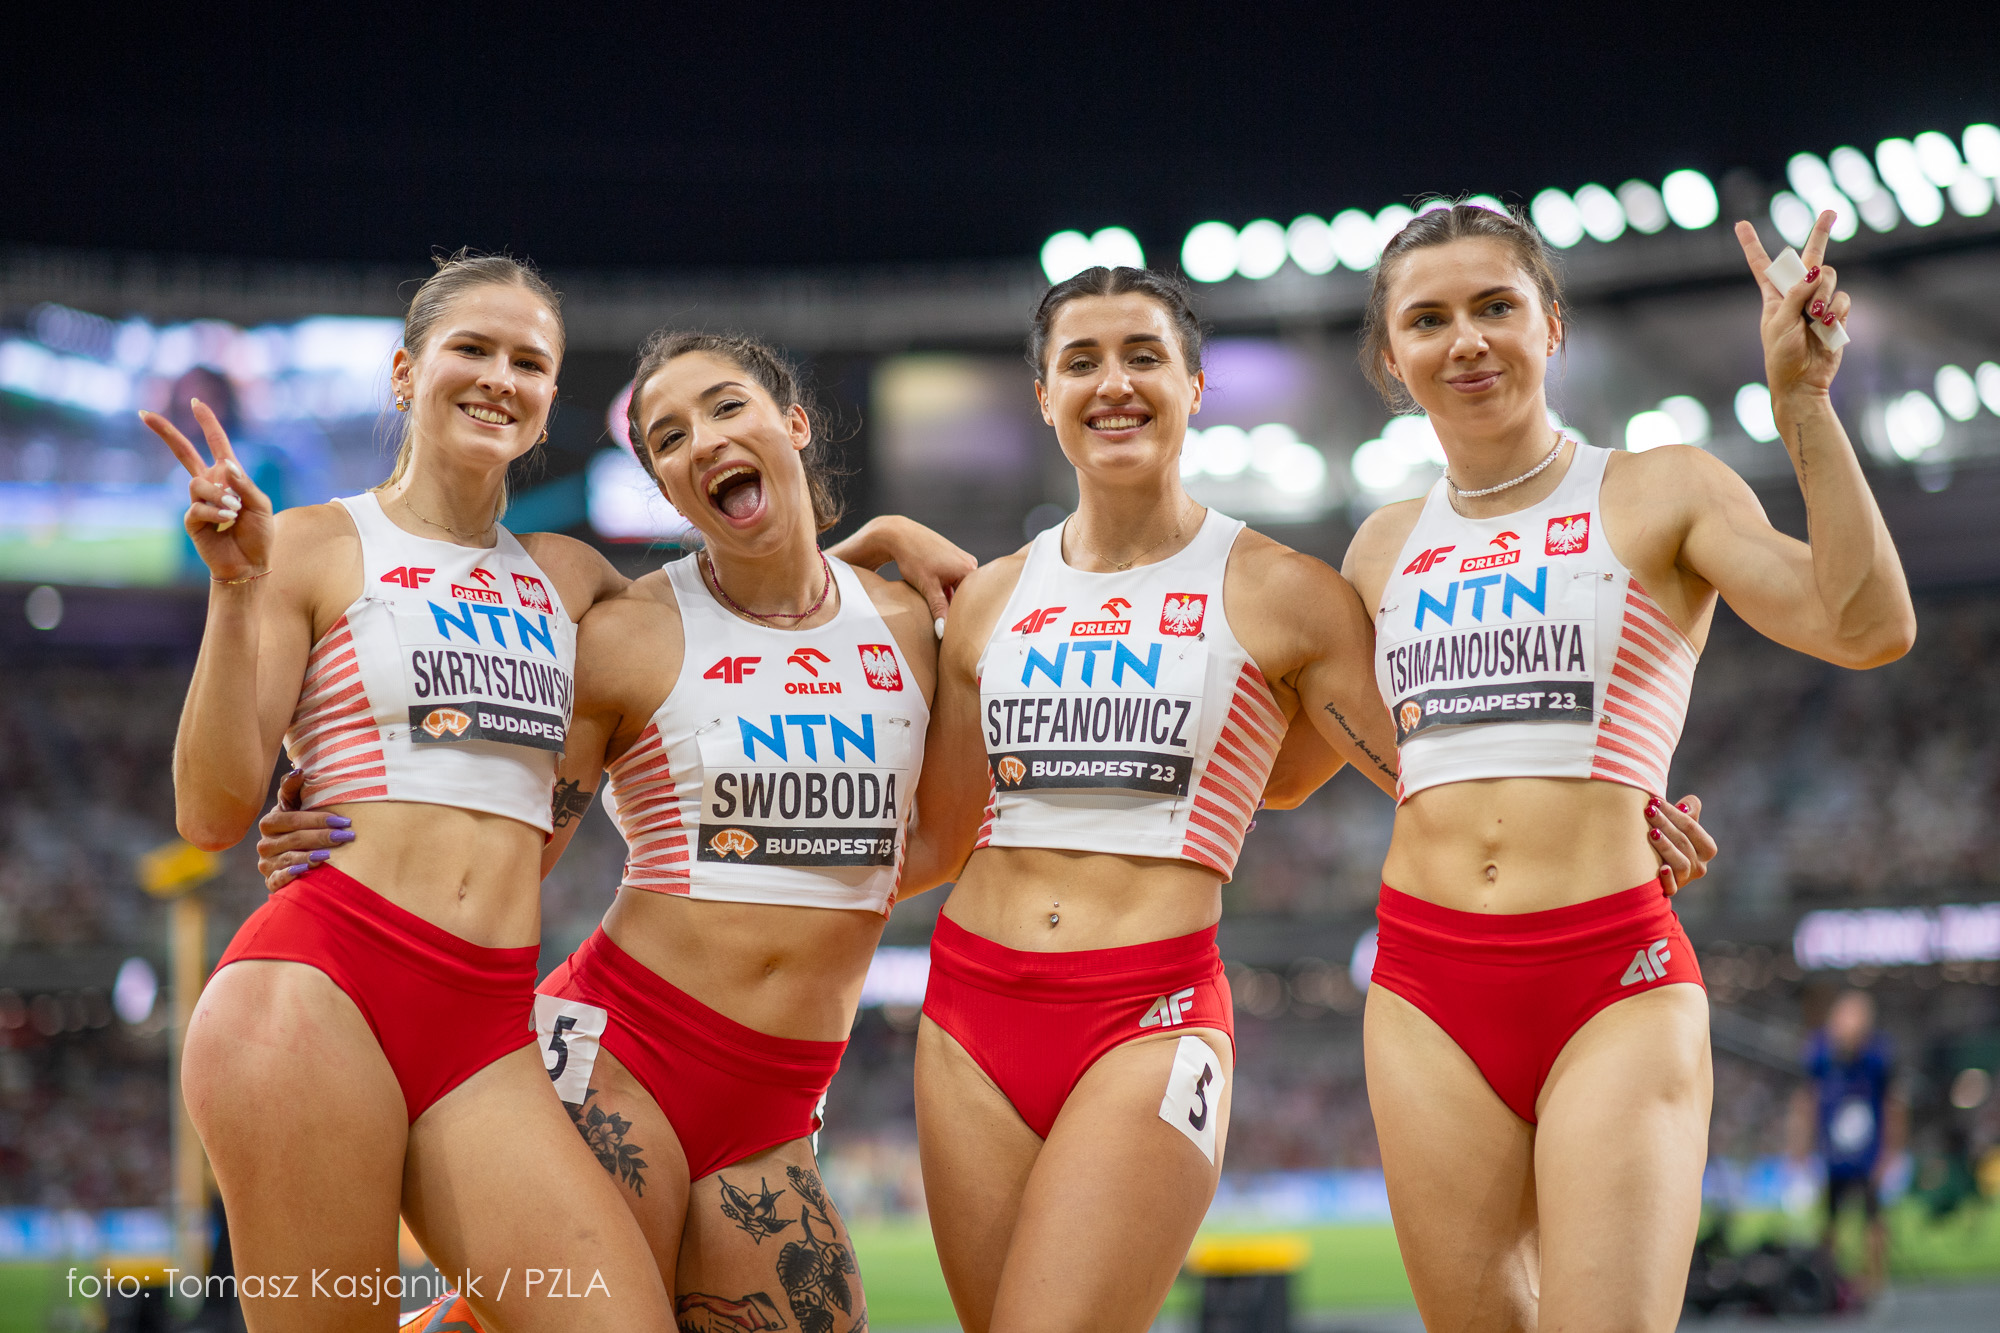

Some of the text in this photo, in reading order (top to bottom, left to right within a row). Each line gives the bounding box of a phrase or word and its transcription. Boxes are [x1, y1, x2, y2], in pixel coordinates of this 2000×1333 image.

[1402, 545, 1456, 575] 4F
[1463, 552, 1518, 571] ORLEN
[380, 566, 436, 589] 4F
[454, 587, 501, 603] ORLEN
[1414, 566, 1548, 632] NTN
[427, 600, 557, 660] NTN
[1011, 606, 1067, 634] 4F
[1074, 622, 1128, 635] ORLEN
[703, 656, 762, 684] 4F
[1021, 639, 1162, 689] NTN
[1386, 624, 1585, 697] TSIMANOUSKAYA
[784, 682, 842, 694] ORLEN
[1425, 692, 1576, 716] BUDAPEST 23
[478, 712, 564, 742] BUDAPES
[988, 697, 1191, 747] STEFANOWICZ
[737, 714, 876, 764] NTN
[1031, 761, 1175, 782] BUDAPEST 23
[712, 771, 897, 819] SWOBODA
[766, 838, 892, 855] BUDAPEST 23
[1620, 937, 1671, 986] 4F
[1139, 987, 1195, 1028] 4F
[546, 1015, 578, 1082] 5
[1188, 1062, 1213, 1132] 5
